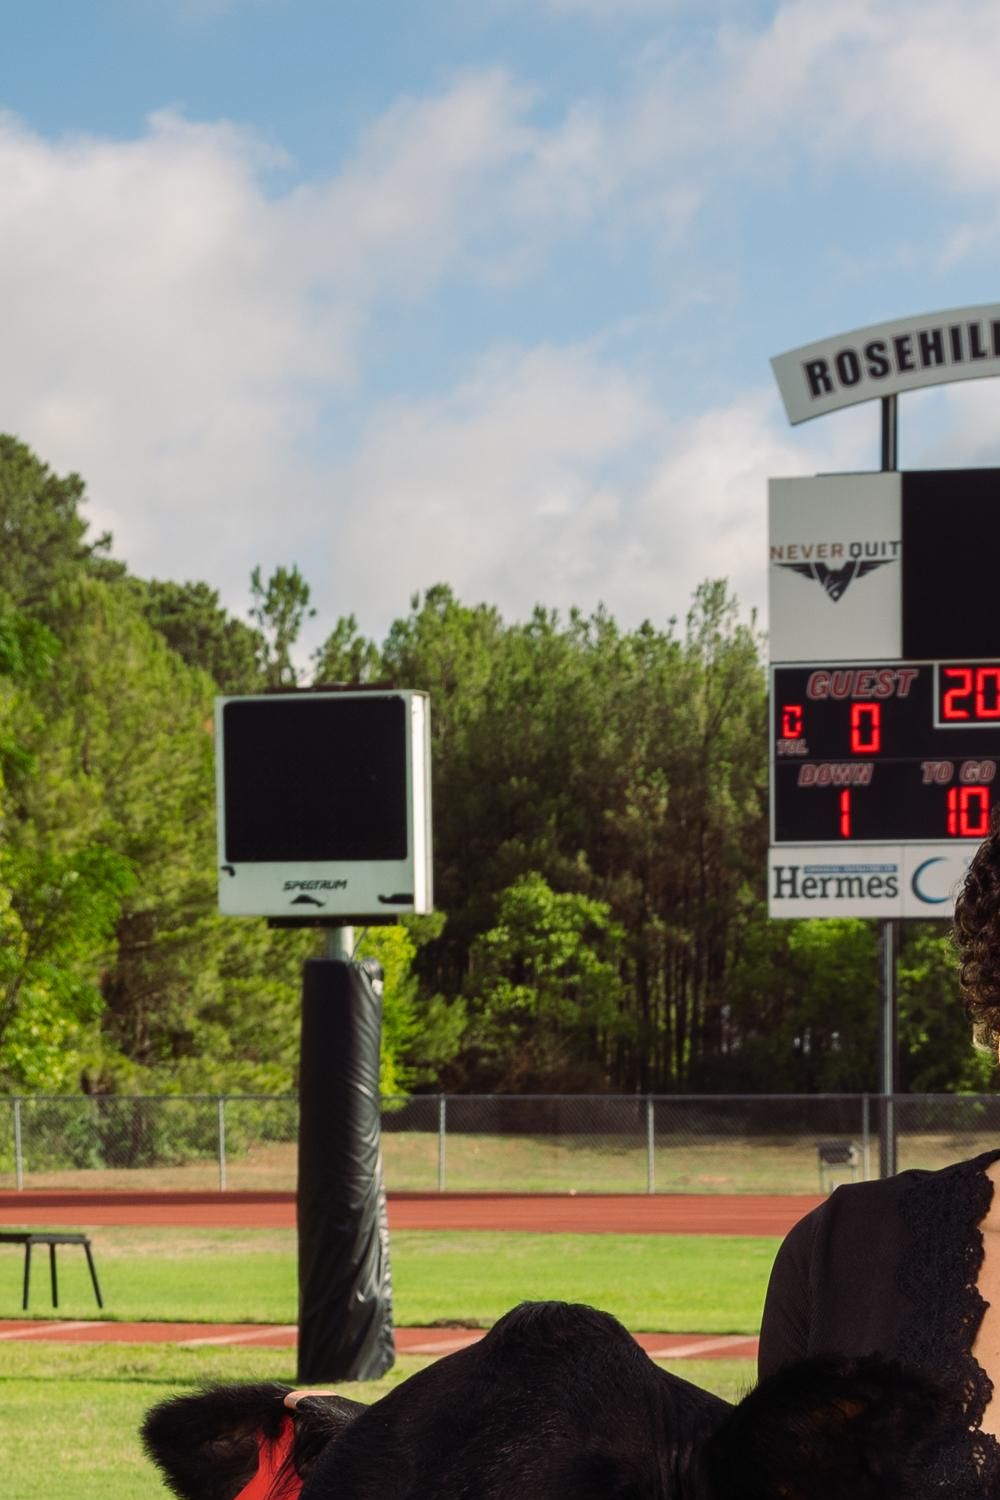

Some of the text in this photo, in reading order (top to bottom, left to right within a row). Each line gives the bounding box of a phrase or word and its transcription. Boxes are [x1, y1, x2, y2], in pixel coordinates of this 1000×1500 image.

[769, 541, 901, 560] NEVER QUIT
[806, 669, 918, 699] GUEST
[850, 702, 881, 753] 0
[798, 763, 874, 788] DOWN
[921, 760, 997, 784] TO GO
[839, 788, 852, 838] 1
[946, 785, 990, 838] 10
[282, 878, 348, 892] SPECTRUM
[772, 865, 899, 900] Hermes
